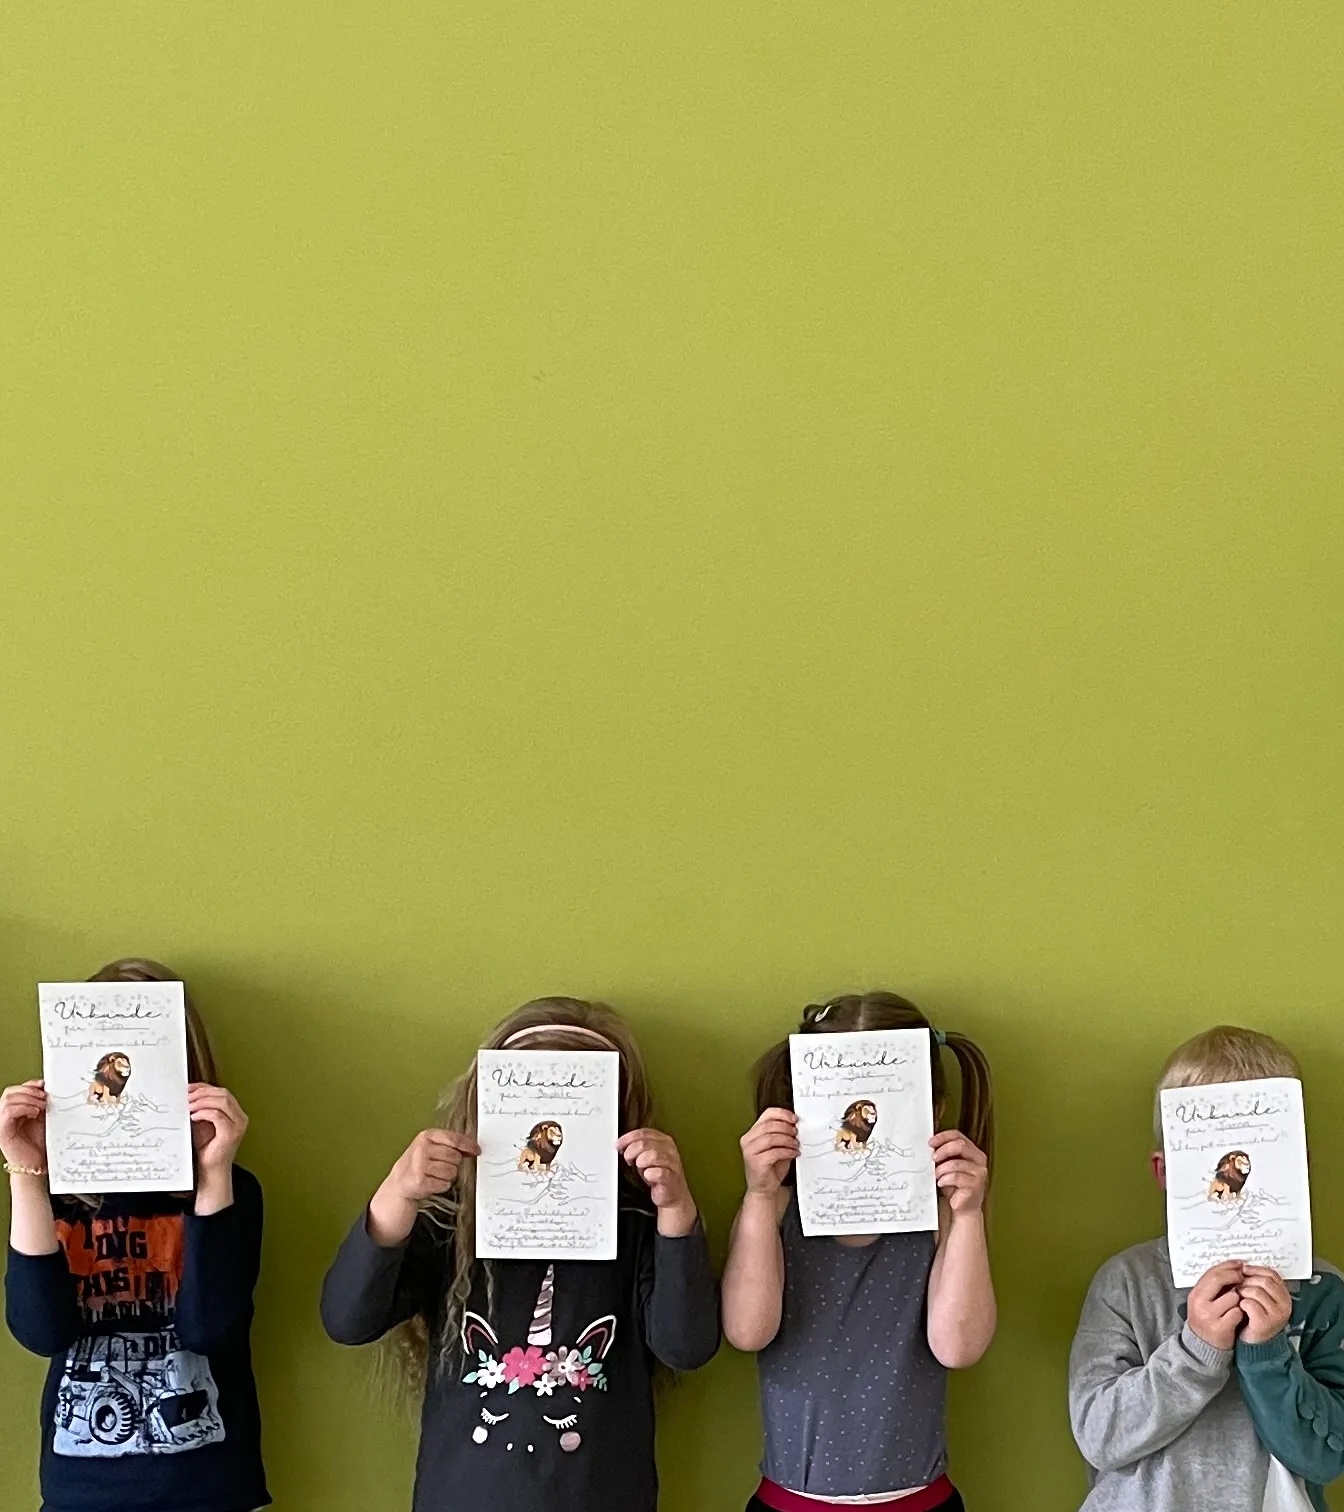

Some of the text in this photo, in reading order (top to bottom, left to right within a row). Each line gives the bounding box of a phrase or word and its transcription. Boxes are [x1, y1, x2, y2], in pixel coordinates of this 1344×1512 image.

[54, 1001, 160, 1020] Urkunde
[803, 1051, 907, 1071] Urkunde
[492, 1068, 595, 1088] Urkunde
[1175, 1100, 1280, 1123] Urkunde
